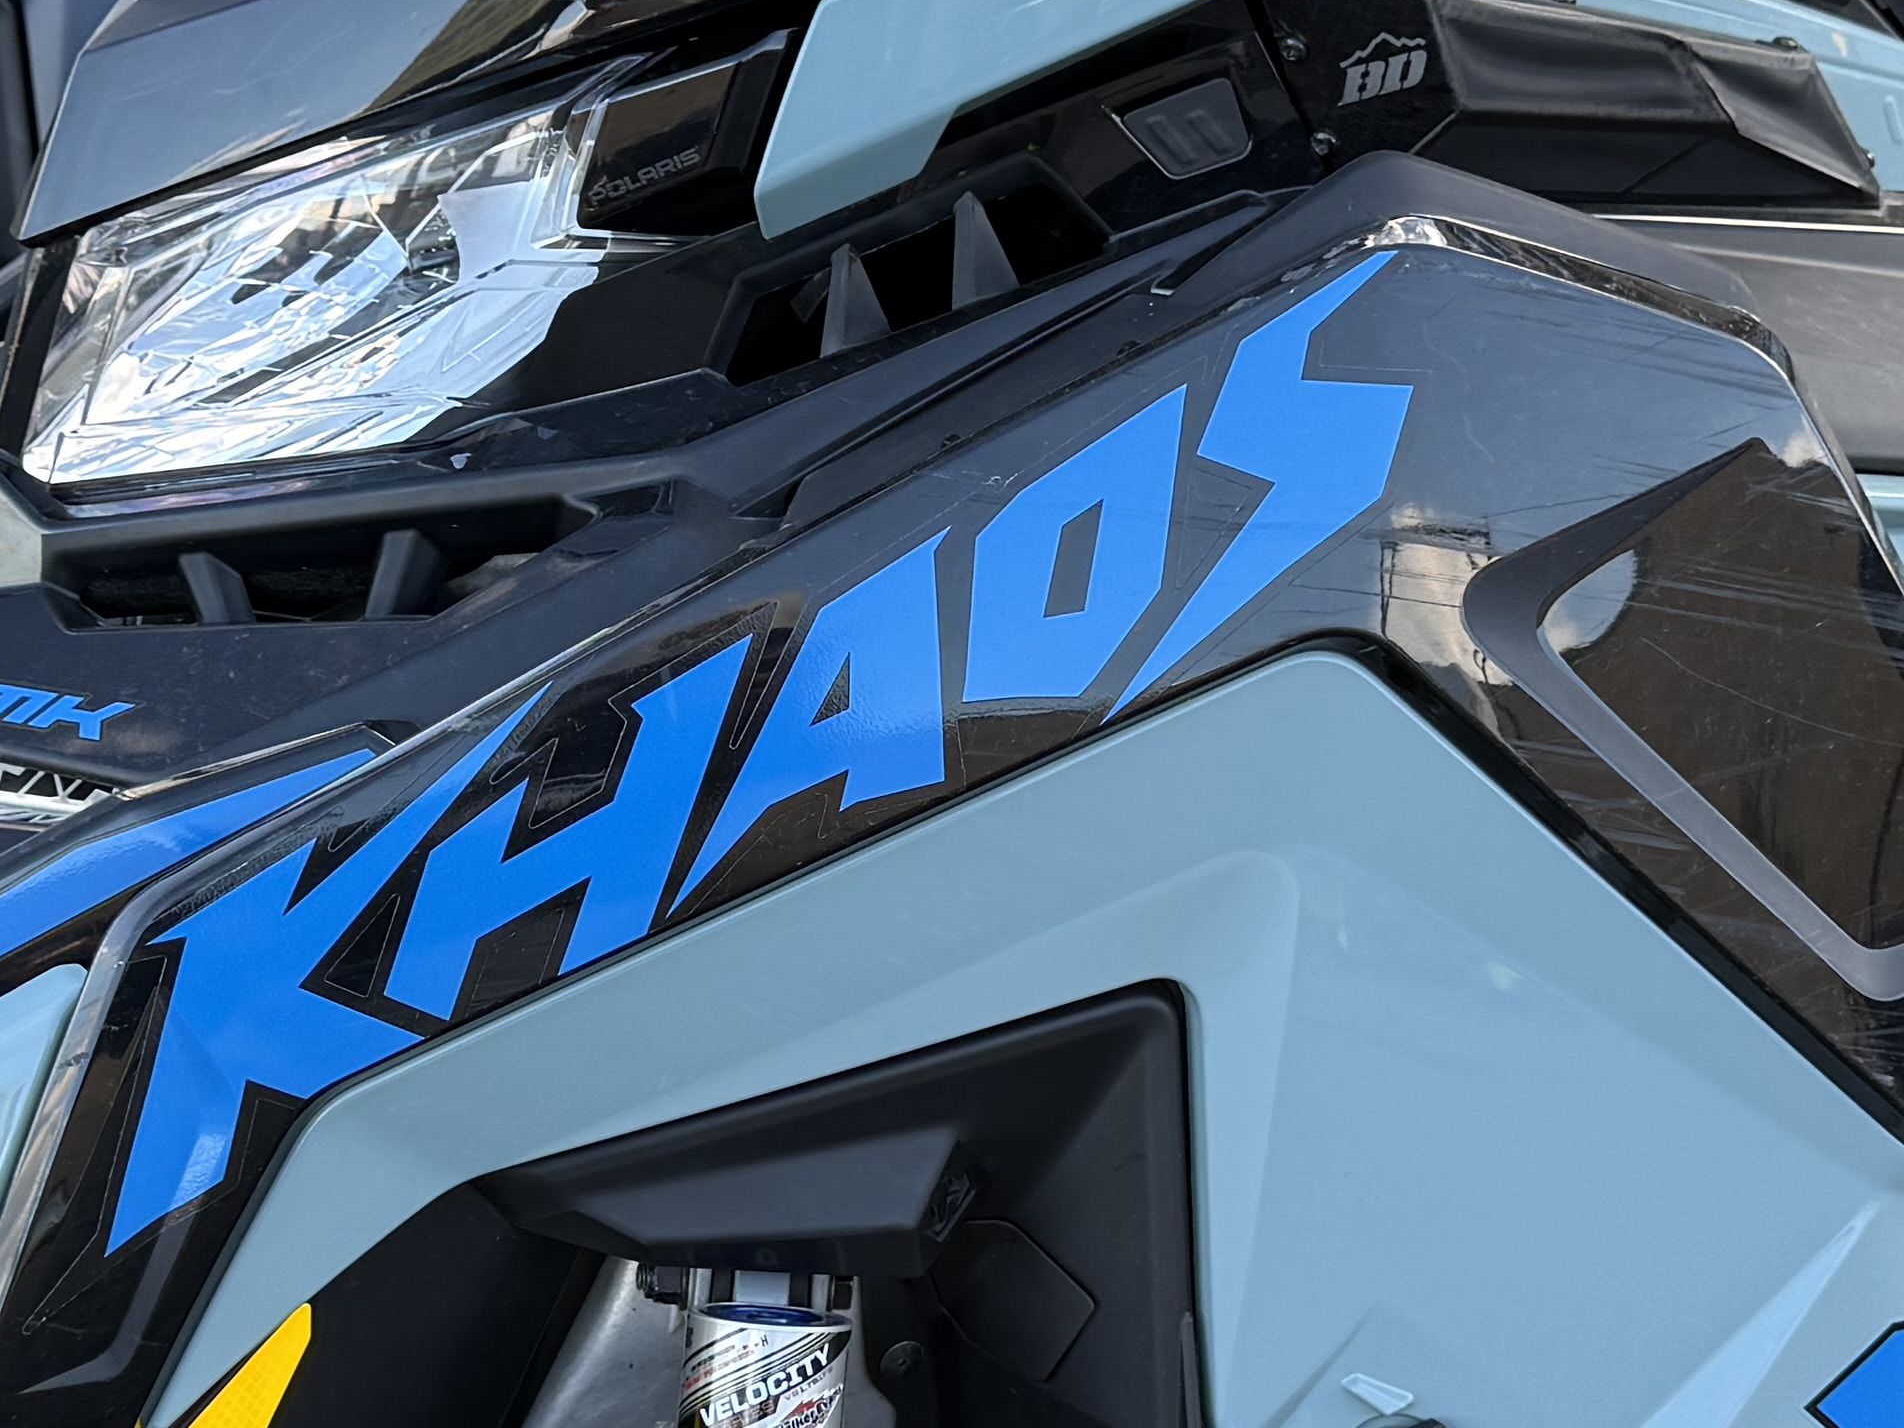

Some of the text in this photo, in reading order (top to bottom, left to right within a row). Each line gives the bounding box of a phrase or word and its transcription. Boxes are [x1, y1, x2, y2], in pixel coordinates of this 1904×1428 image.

[1337, 49, 1428, 107] BD
[588, 145, 701, 207] POLARIS
[104, 248, 1414, 1259] KHAOS
[699, 1342, 831, 1428] VELOCITY
